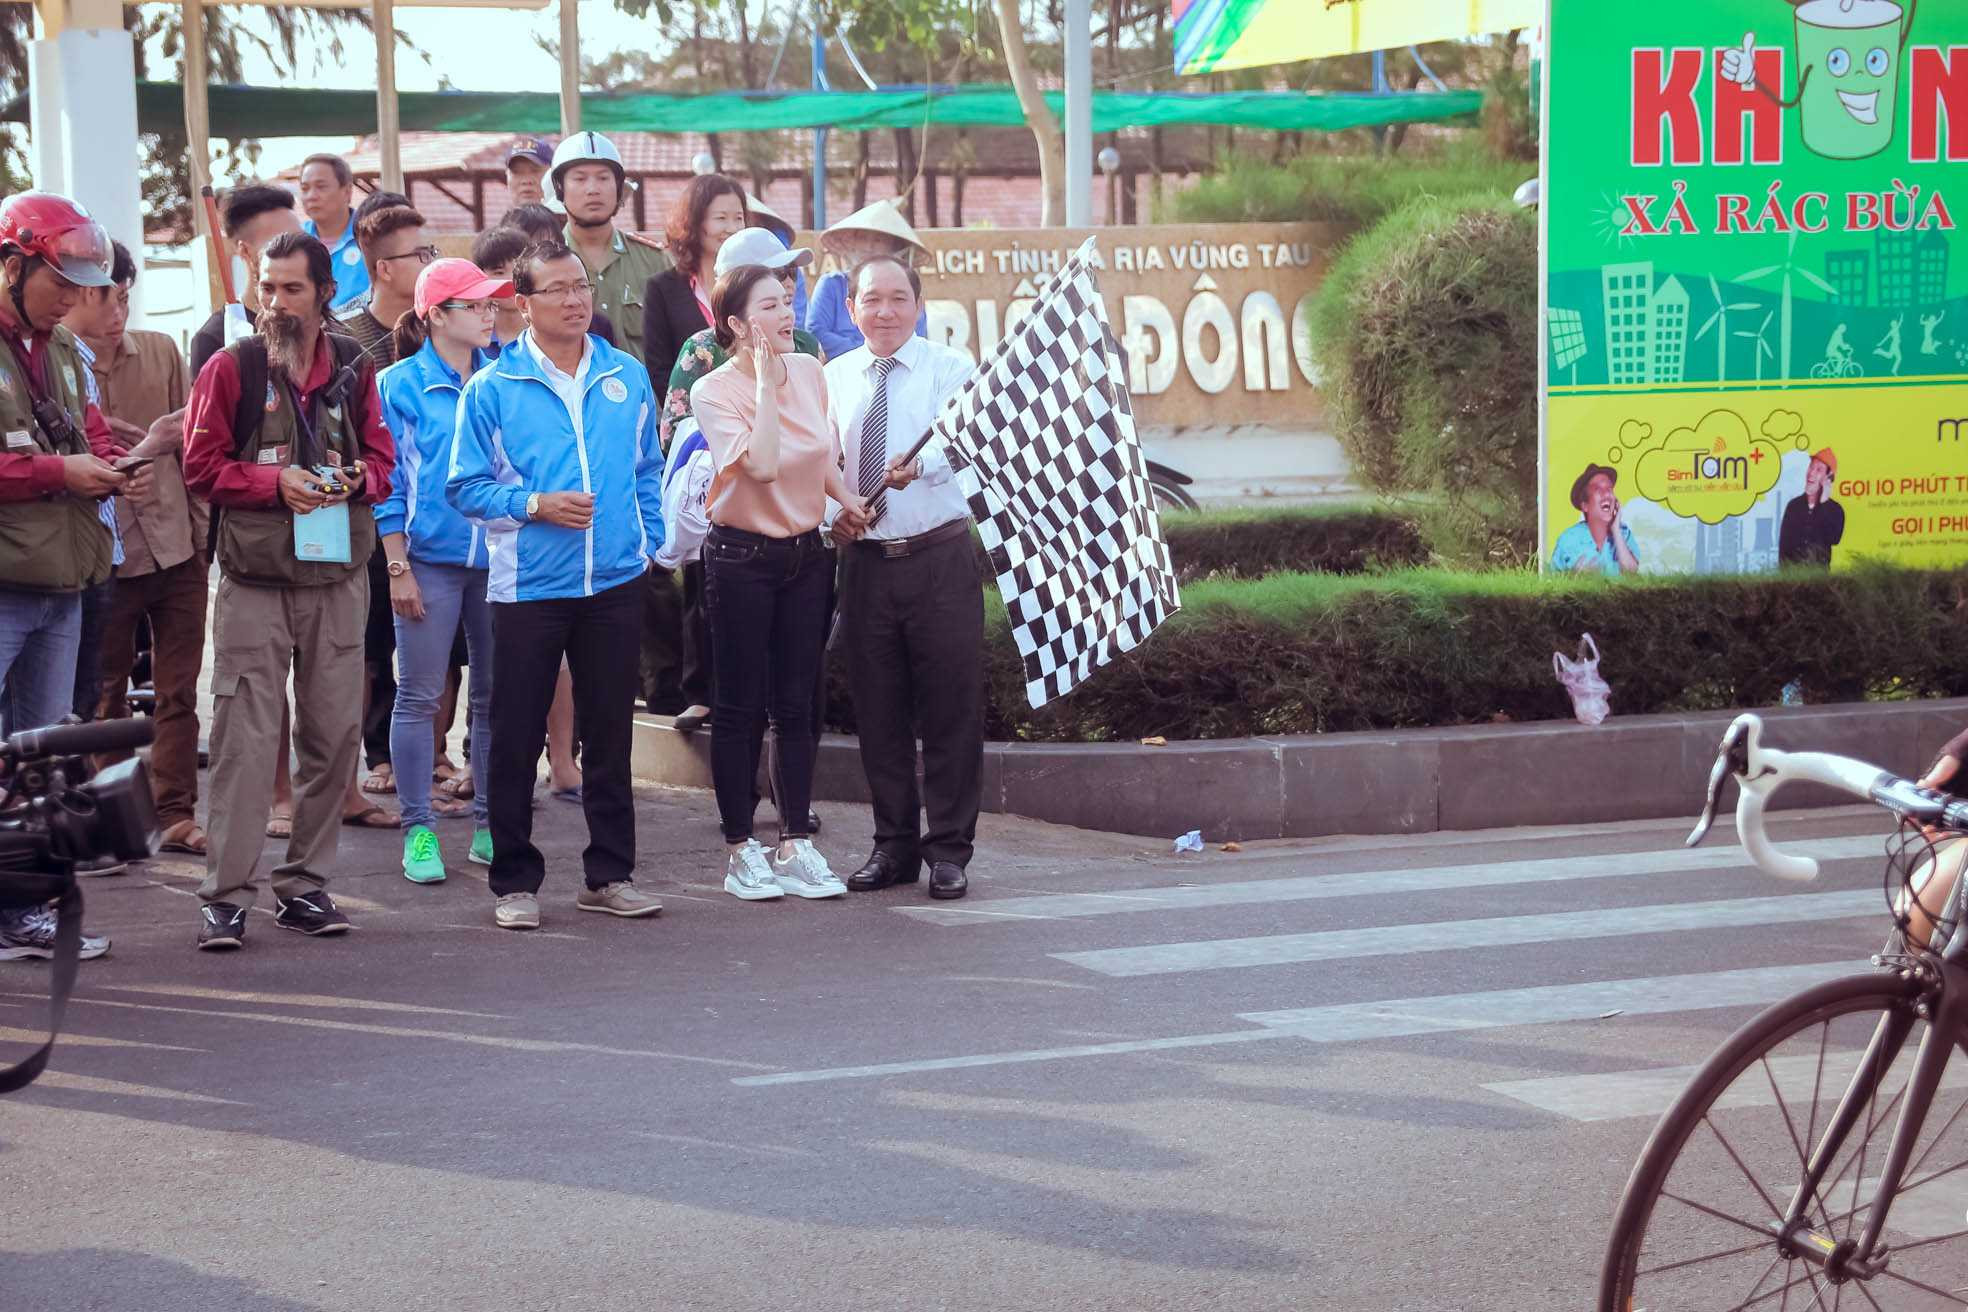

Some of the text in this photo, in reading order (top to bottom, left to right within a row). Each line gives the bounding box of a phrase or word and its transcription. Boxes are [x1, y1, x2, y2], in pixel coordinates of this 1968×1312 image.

[1619, 177, 1955, 237] XẢ RÁC BỪA
[991, 239, 1060, 273] TỈNH
[1114, 246, 1165, 275] RỊA
[1169, 239, 1249, 270] VŨNG
[1838, 479, 1871, 500] GỌI
[1900, 472, 1951, 495] PHÚT
[1892, 516, 1923, 537] GỌI
